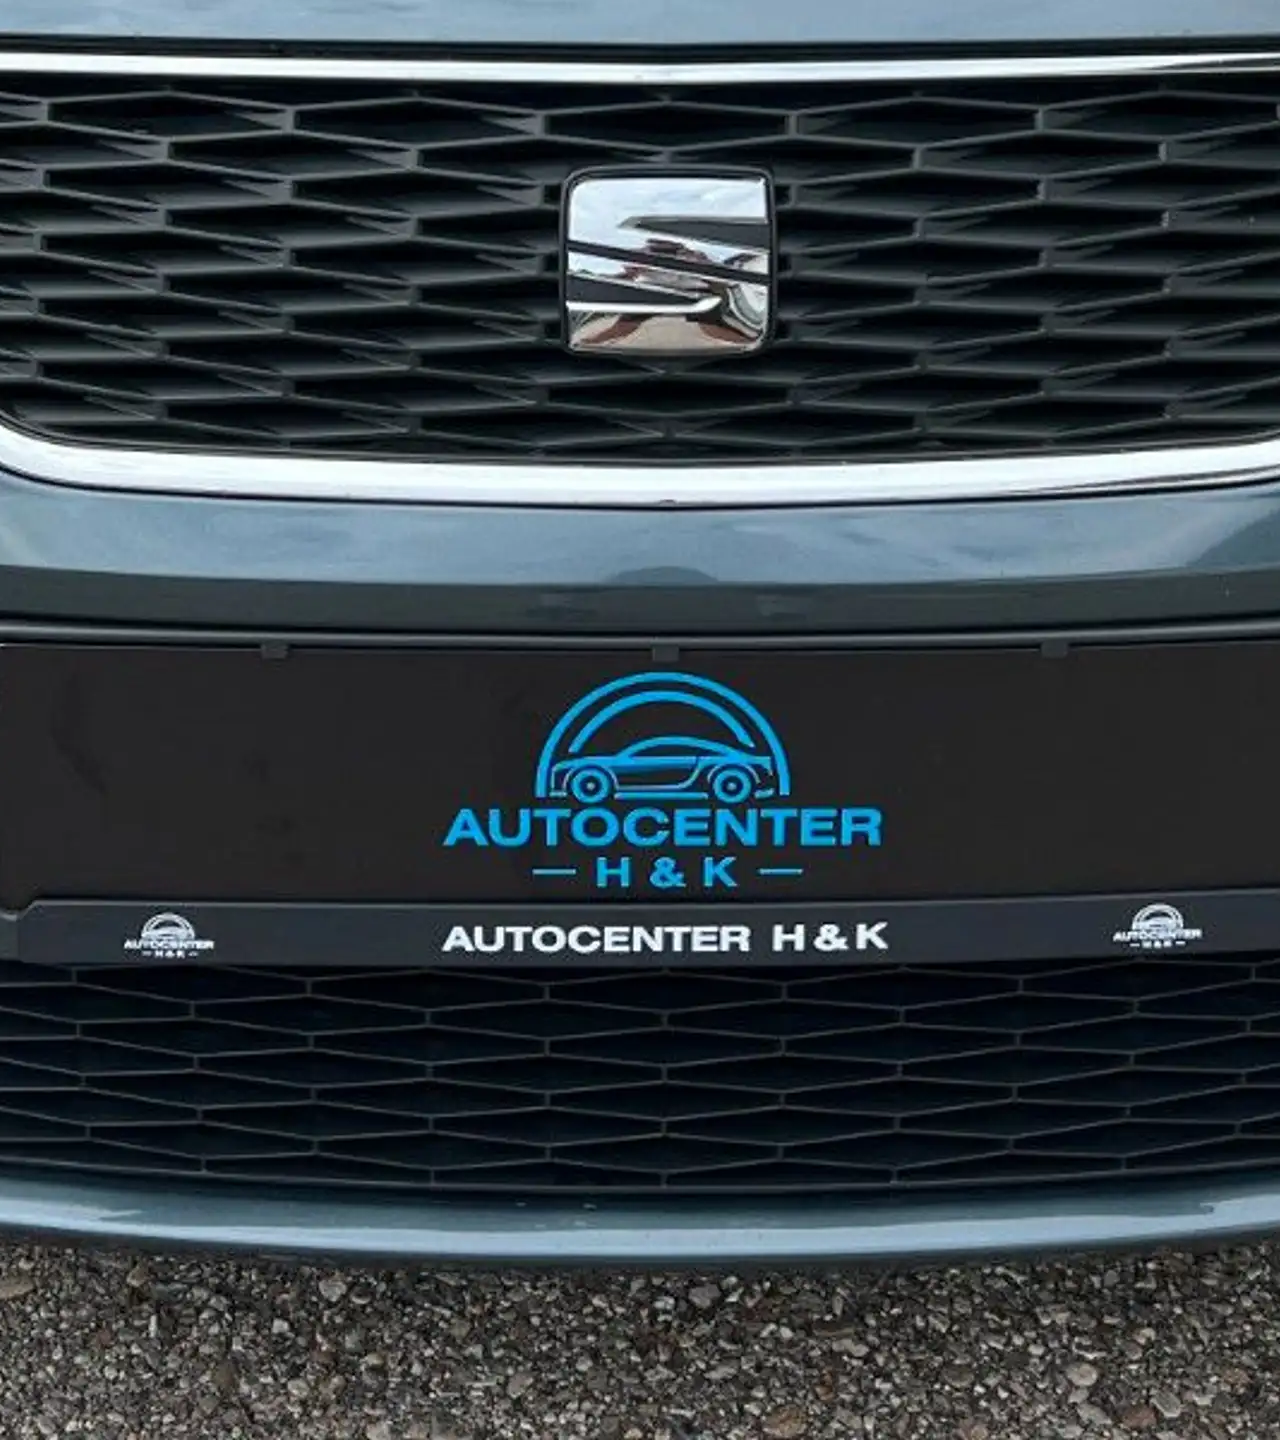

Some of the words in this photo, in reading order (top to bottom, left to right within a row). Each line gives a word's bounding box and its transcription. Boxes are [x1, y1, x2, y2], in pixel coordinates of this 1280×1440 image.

[443, 807, 883, 847] AUTOCENTER
[596, 856, 631, 888] H
[649, 856, 686, 888] &
[703, 856, 738, 888] K
[441, 925, 753, 953] AUTOCENTER
